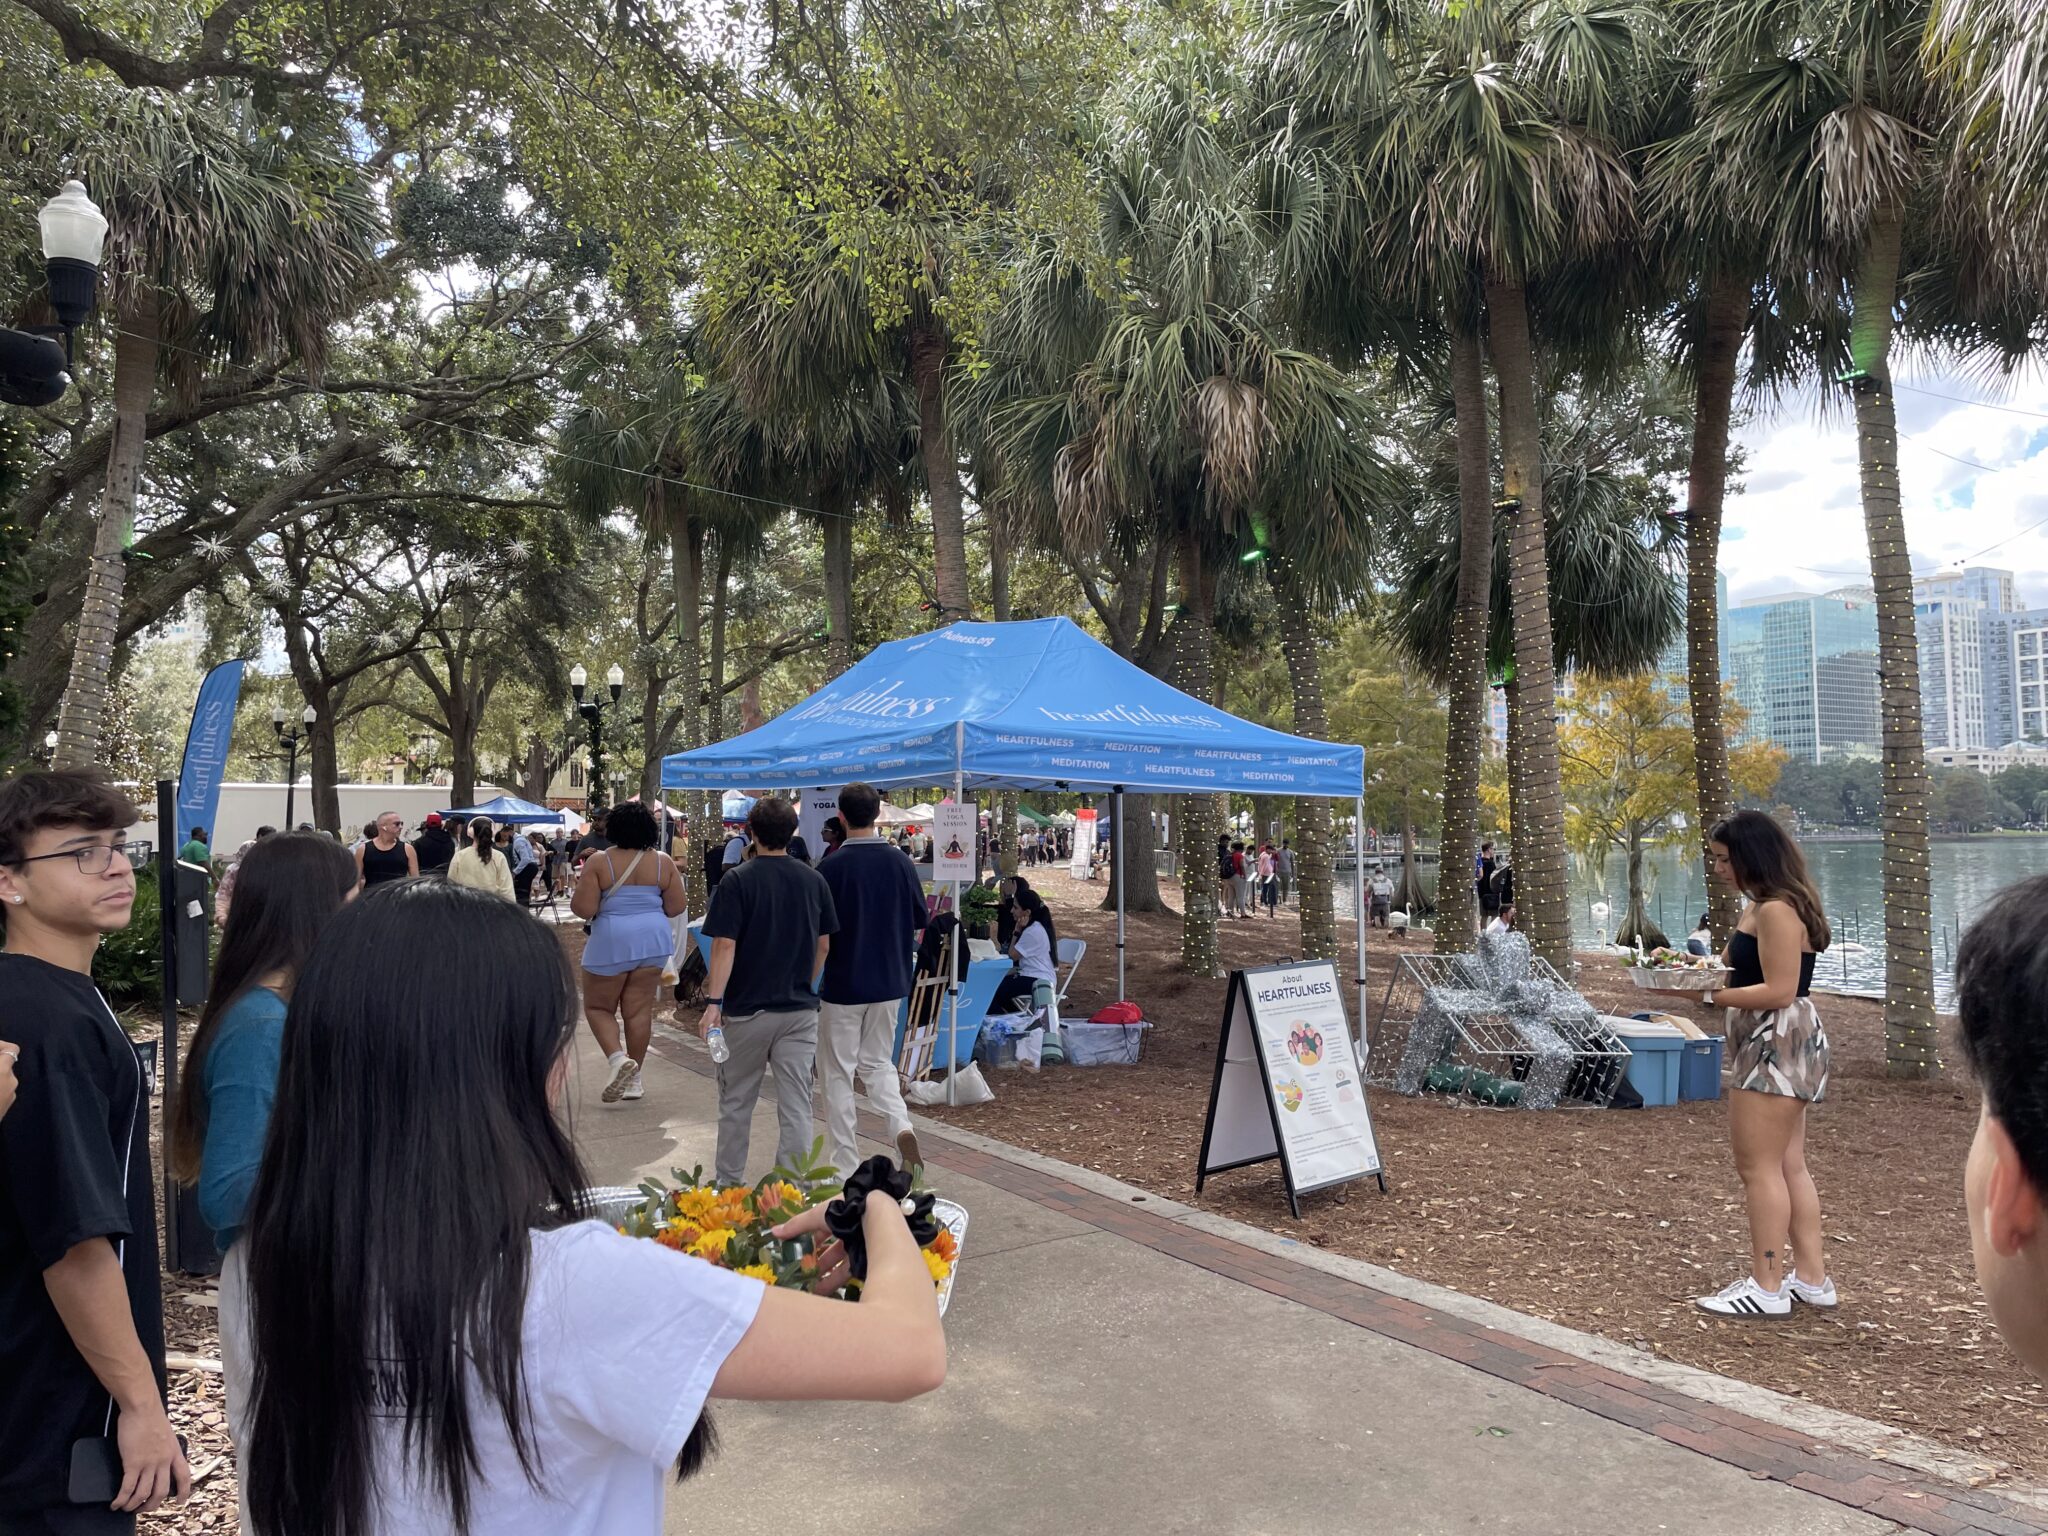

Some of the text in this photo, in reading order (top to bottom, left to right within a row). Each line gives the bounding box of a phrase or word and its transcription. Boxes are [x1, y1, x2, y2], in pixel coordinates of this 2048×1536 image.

[788, 677, 954, 722] hfulness
[1036, 703, 1223, 728] heartfulness
[180, 699, 223, 811] heartfulness
[995, 734, 1339, 768] HEARTFULNESS MEDITATION HEARTFULNESS MEDITATION
[1051, 756, 1295, 783] MEDITATION HEARTFULNESS MEDITATION
[1257, 981, 1332, 1004] HEARTFULNESS
[1282, 974, 1303, 985] About
